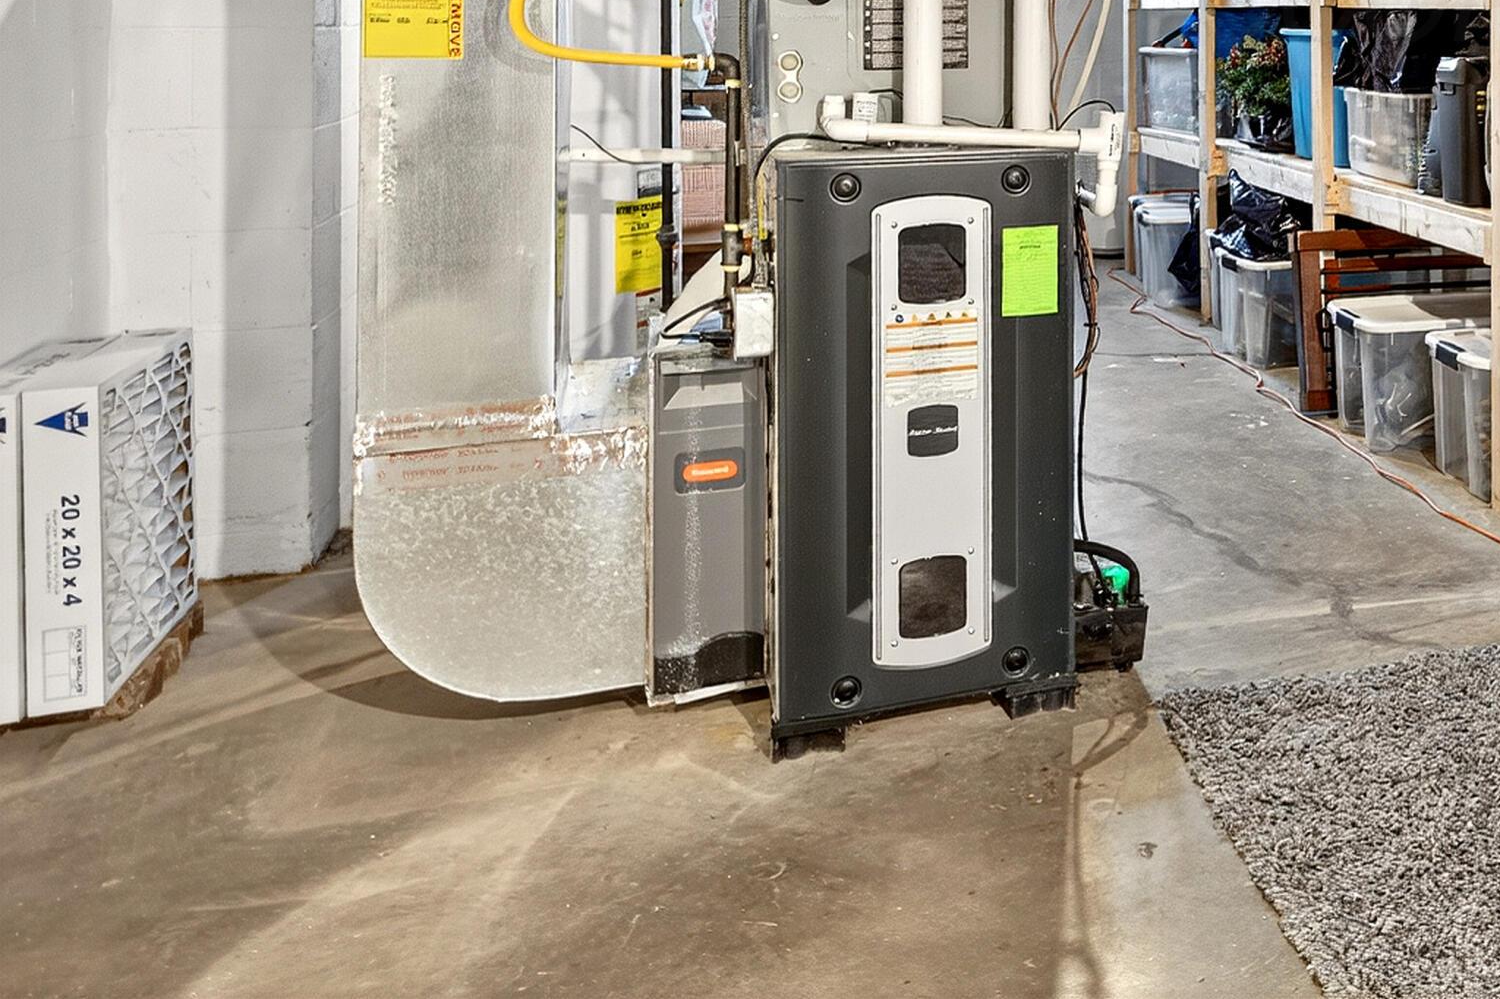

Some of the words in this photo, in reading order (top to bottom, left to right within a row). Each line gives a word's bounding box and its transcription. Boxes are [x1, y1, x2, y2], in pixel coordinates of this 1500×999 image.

[61, 494, 80, 520] 20
[62, 527, 76, 539] x
[62, 545, 82, 569] 20
[63, 577, 77, 588] x
[63, 593, 83, 606] 4
